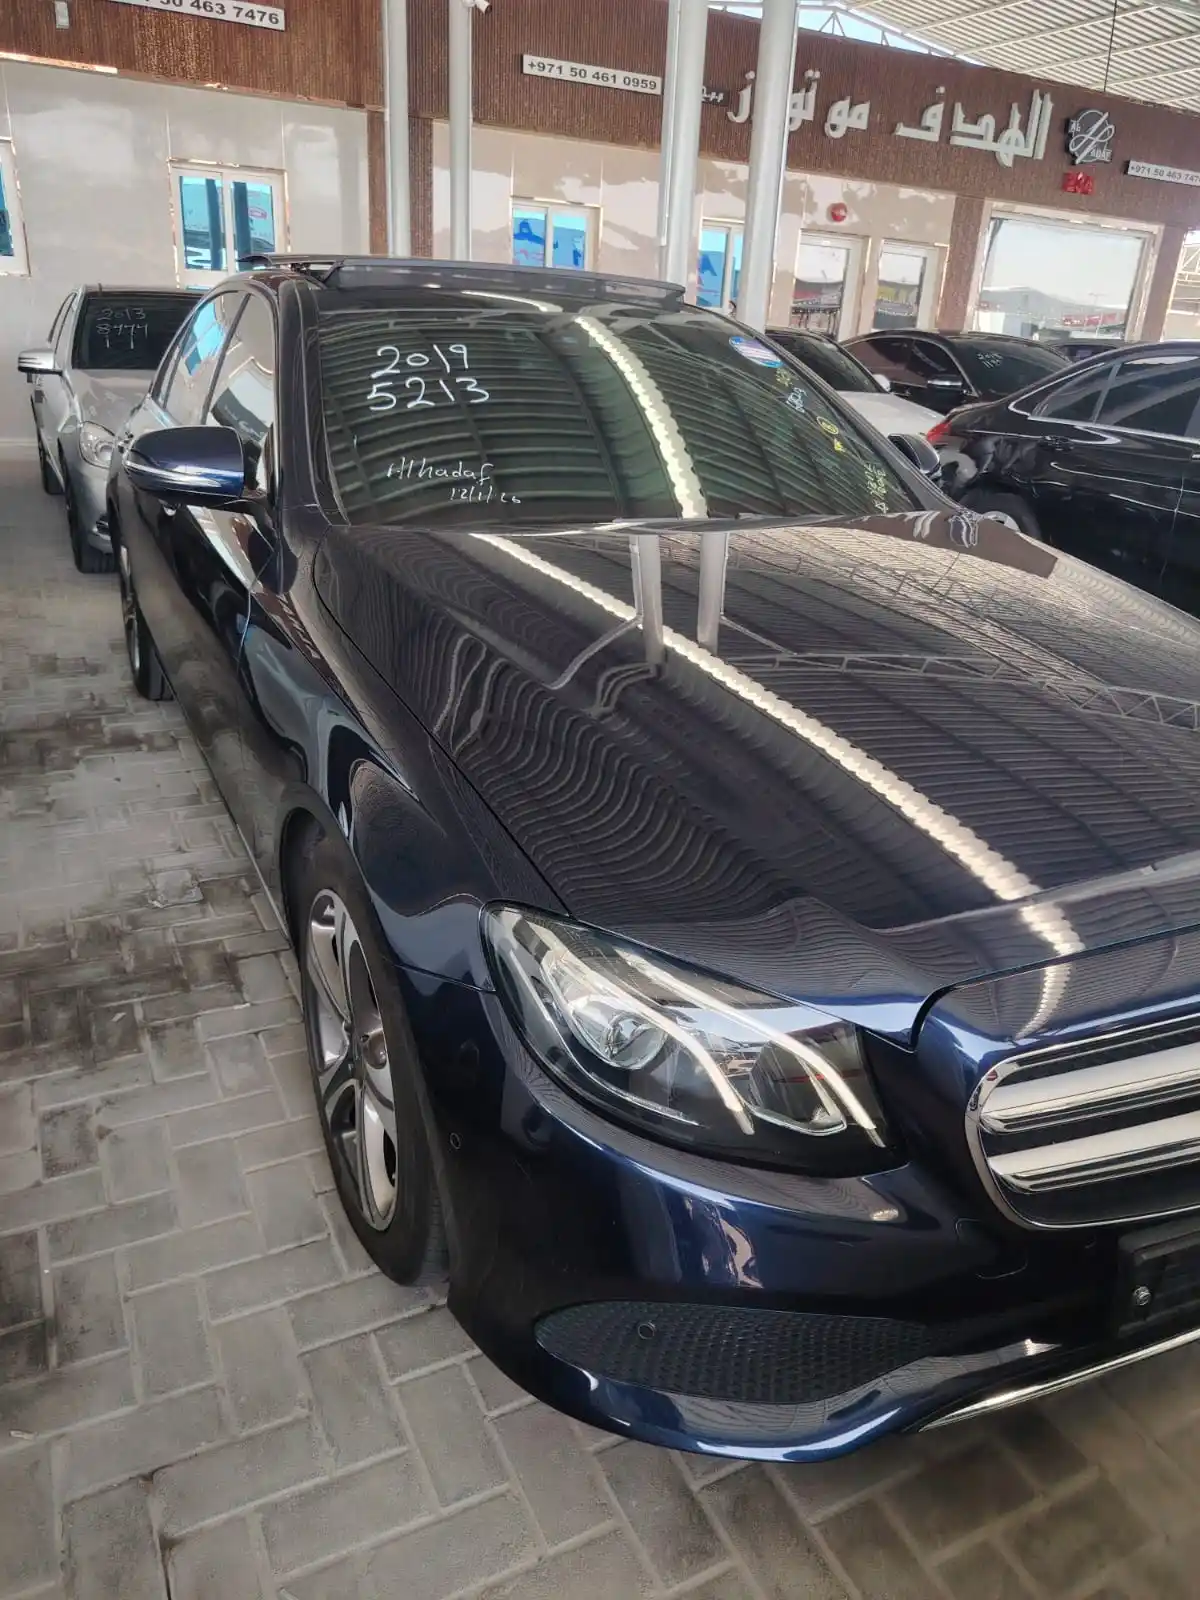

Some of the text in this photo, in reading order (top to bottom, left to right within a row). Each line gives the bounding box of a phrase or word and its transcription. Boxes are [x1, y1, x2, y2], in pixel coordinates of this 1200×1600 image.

[190, 0, 226, 15] 463
[232, 6, 280, 25] 7476
[528, 60, 657, 91] +971 50 461 0959
[892, 86, 1054, 168] الهدف
[1183, 173, 1200, 184] 747
[370, 344, 469, 379] 2019
[367, 376, 490, 411] 5213
